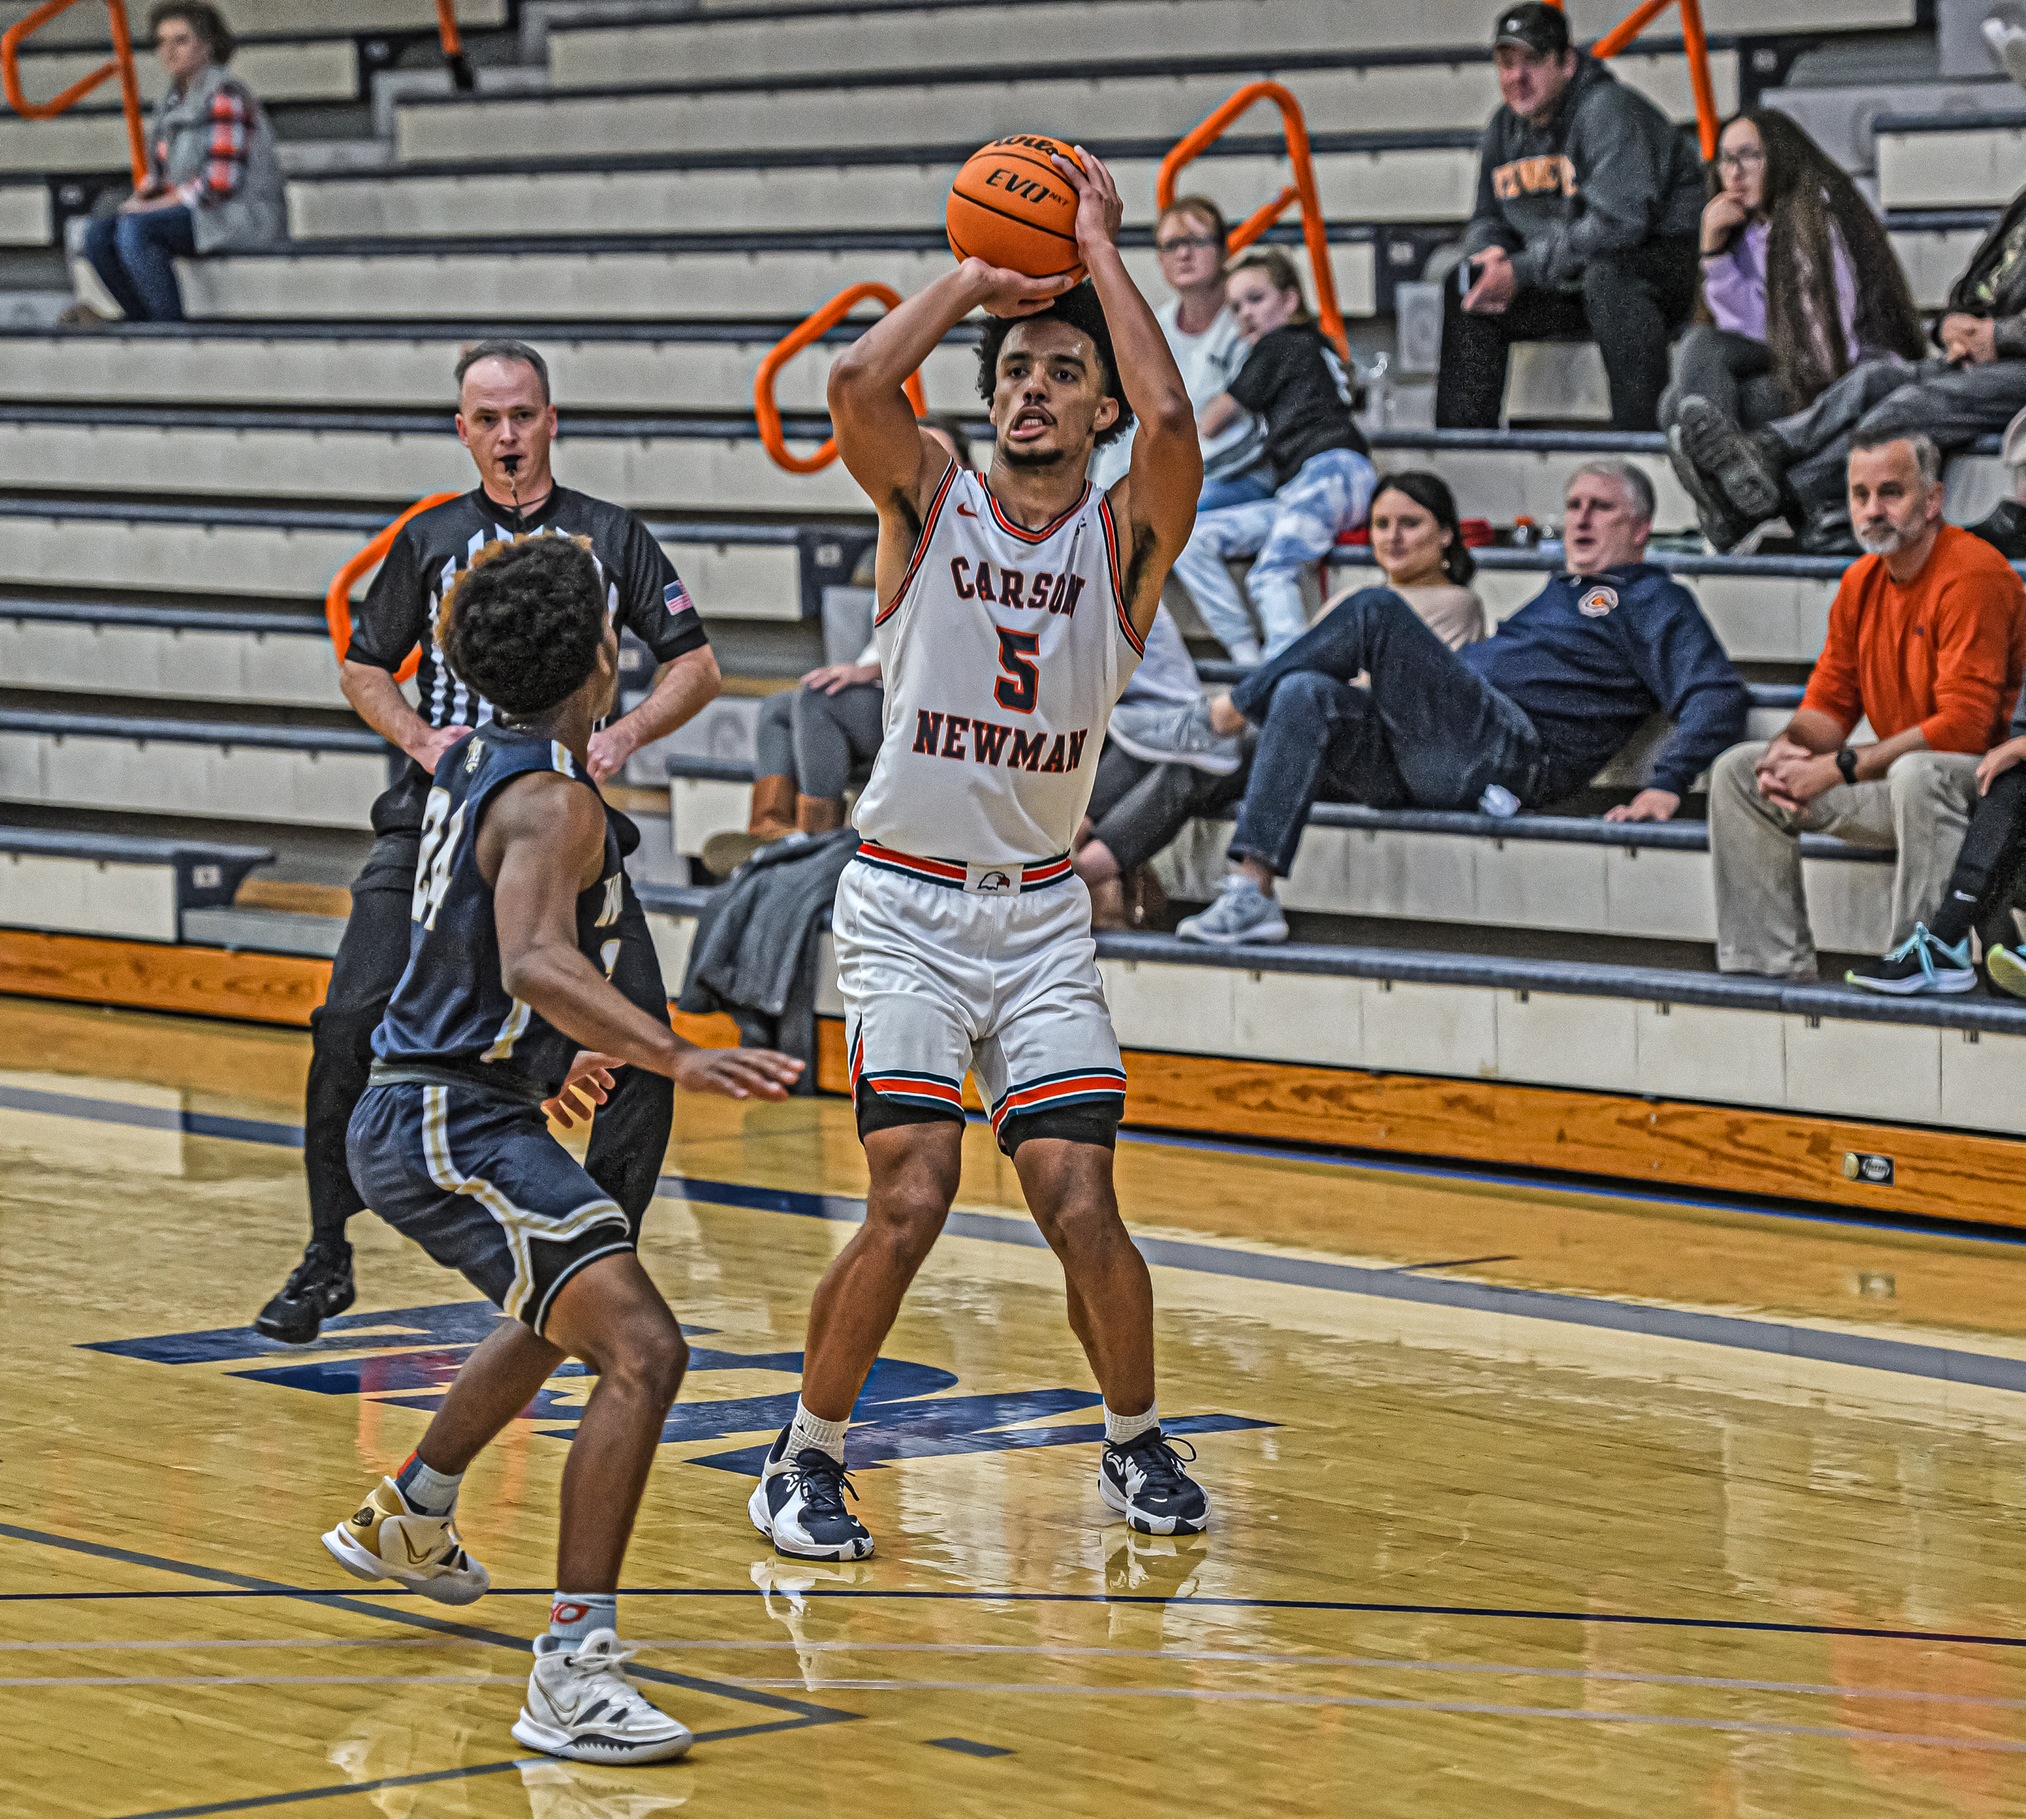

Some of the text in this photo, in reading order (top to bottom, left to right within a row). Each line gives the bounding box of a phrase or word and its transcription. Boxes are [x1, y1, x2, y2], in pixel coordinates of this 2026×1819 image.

[985, 168, 1050, 204] EVO
[950, 556, 1086, 619] CARSON
[993, 625, 1040, 715] 5
[912, 708, 1088, 774] NEWMAN
[411, 786, 468, 931] 24
